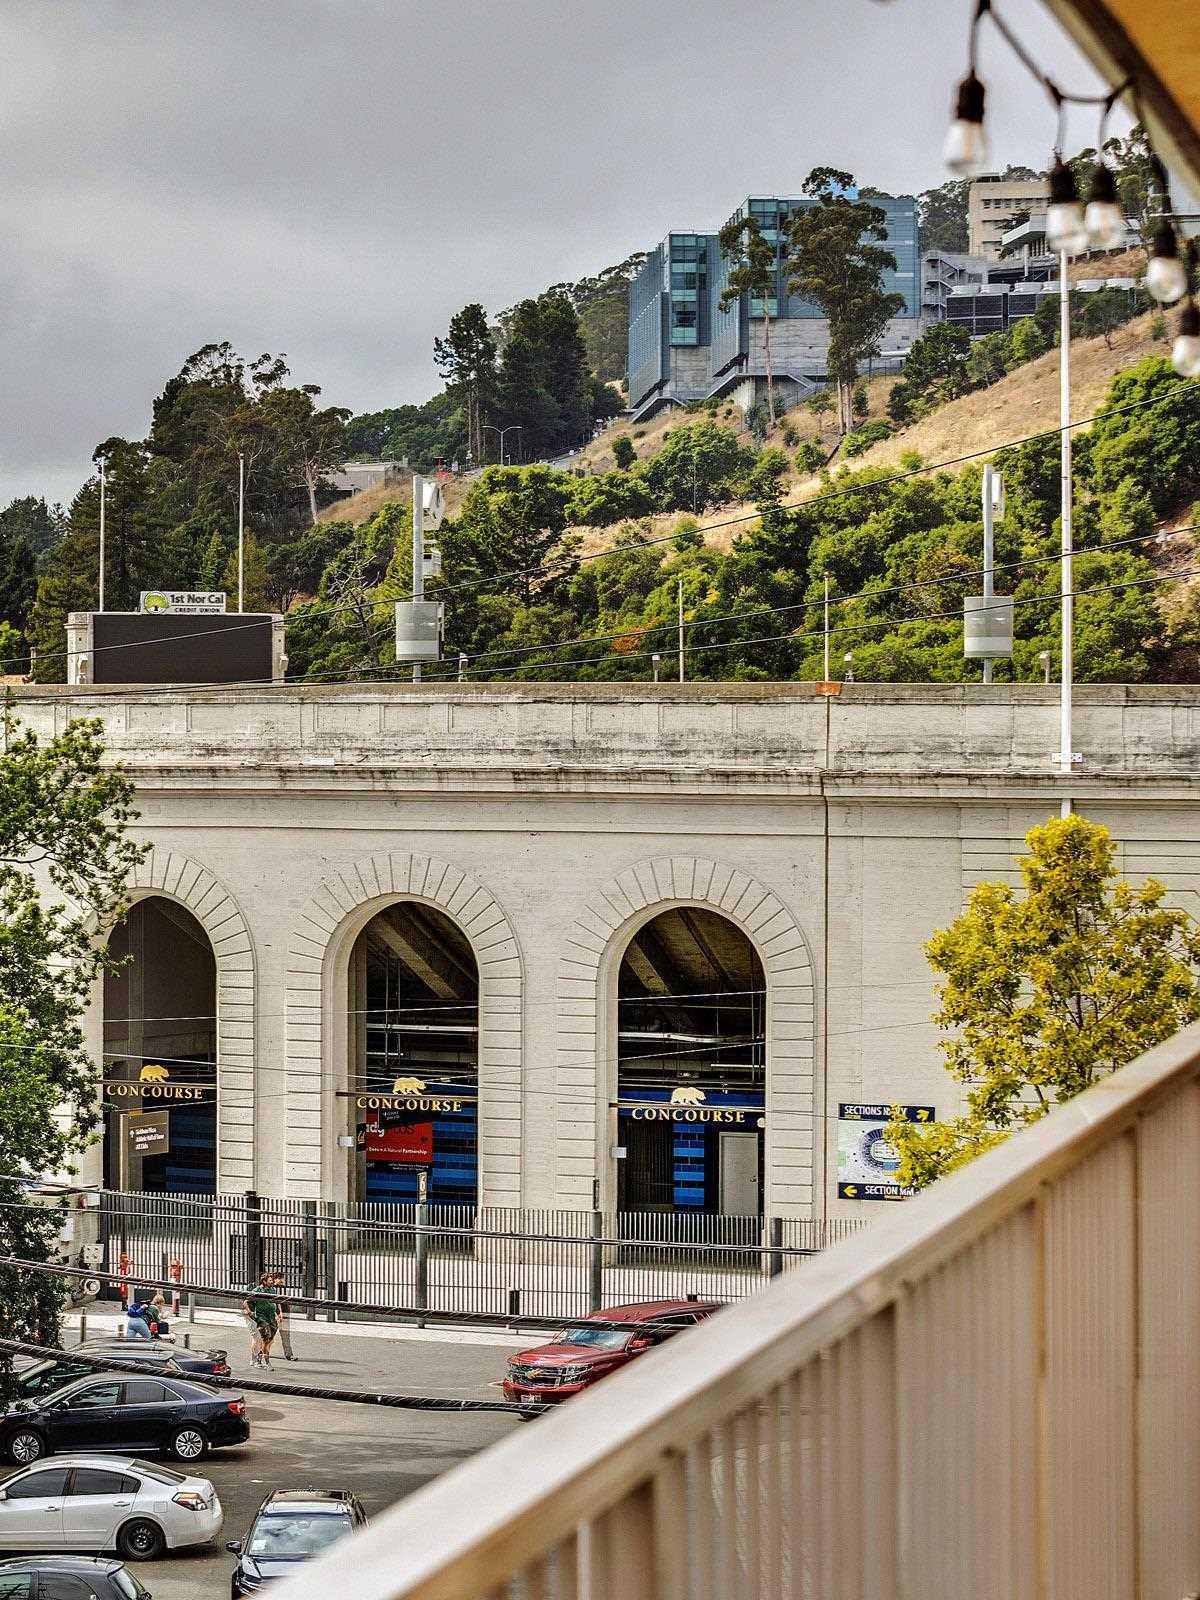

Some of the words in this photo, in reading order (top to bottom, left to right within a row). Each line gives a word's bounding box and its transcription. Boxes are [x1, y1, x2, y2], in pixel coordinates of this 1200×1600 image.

[170, 594, 185, 604] 1st
[187, 594, 205, 604] Nor
[208, 594, 224, 604] Cal
[106, 1085, 203, 1099] CONCOURSE
[357, 1097, 462, 1112] CONCOURSE
[844, 1105, 882, 1116] SECTIONS
[632, 1107, 746, 1123] CONCOURSE
[864, 1185, 898, 1195] SECTION
